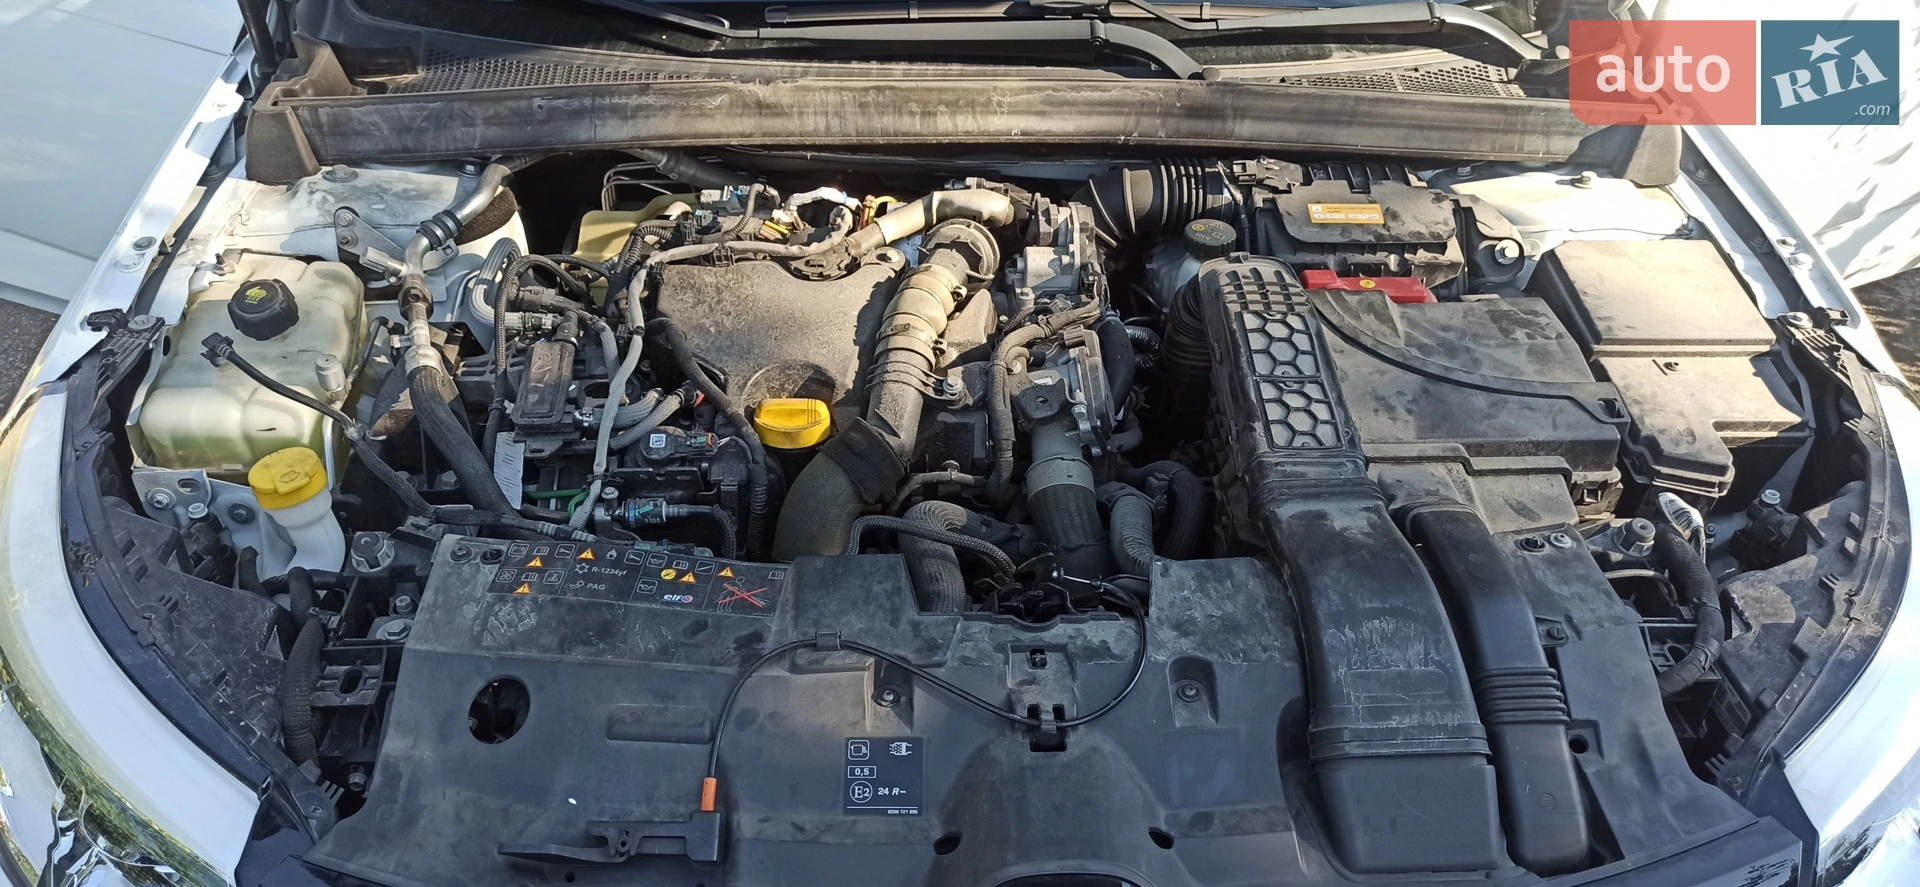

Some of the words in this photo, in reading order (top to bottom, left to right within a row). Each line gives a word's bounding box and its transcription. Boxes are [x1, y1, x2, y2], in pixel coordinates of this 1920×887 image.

[591, 566, 627, 576] R-1234yf
[586, 582, 606, 591] PAG
[854, 767, 870, 777] 0,5
[854, 785, 871, 799] E2
[877, 787, 889, 796] 24
